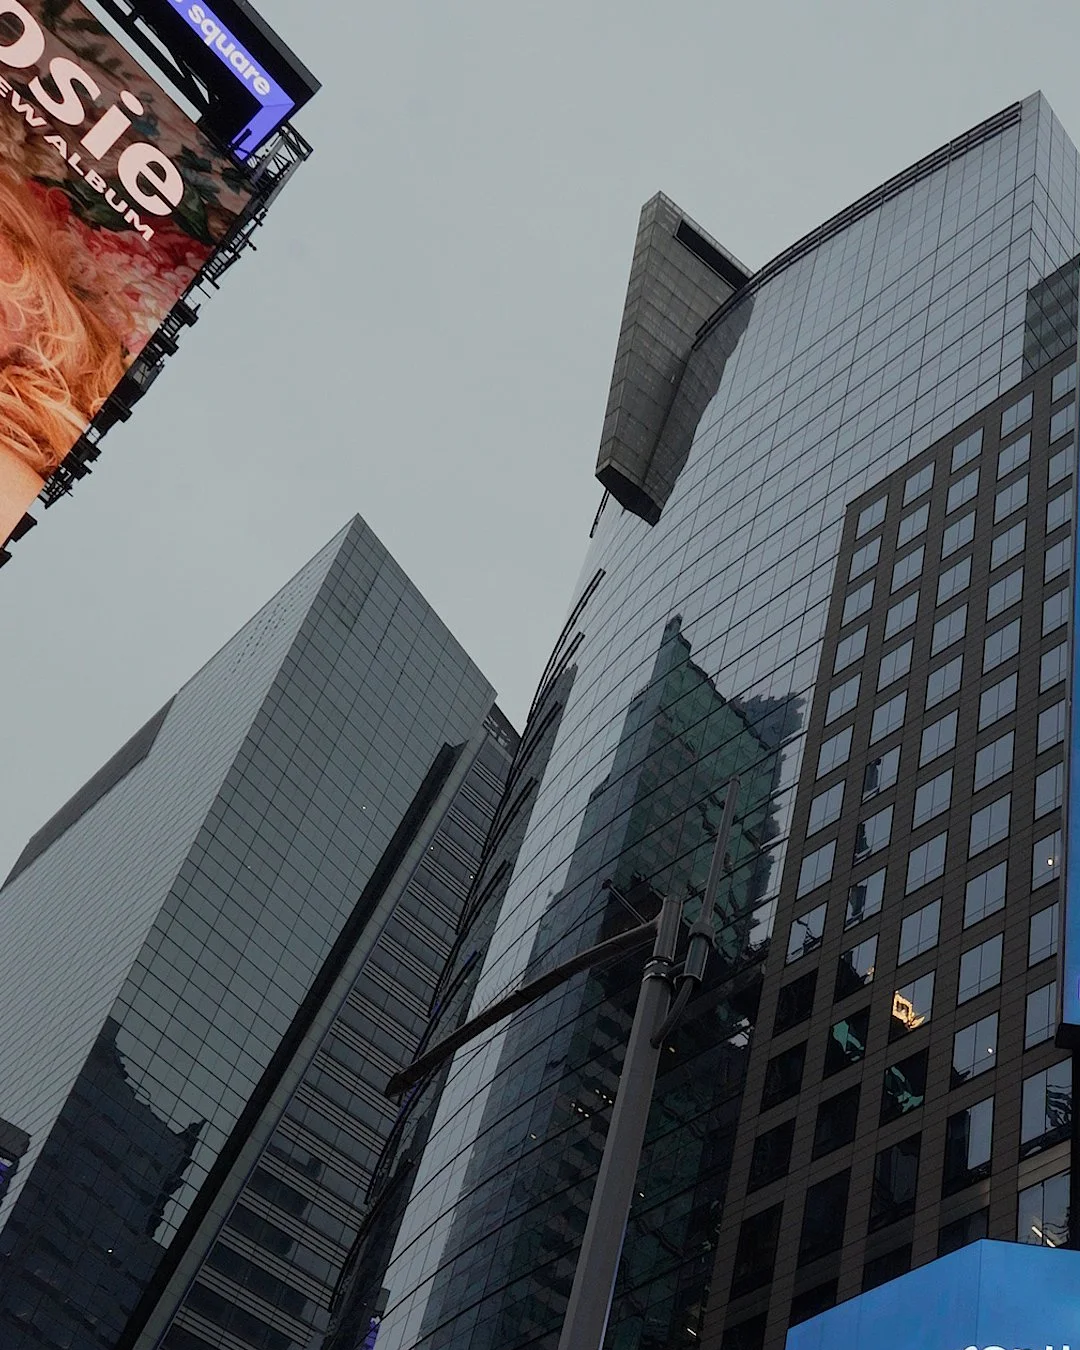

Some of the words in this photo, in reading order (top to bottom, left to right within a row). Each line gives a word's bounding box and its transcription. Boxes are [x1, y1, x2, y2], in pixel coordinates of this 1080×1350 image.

[188, 4, 270, 96] square
[0, 0, 184, 216] osie
[43, 134, 154, 242] ALBUM
